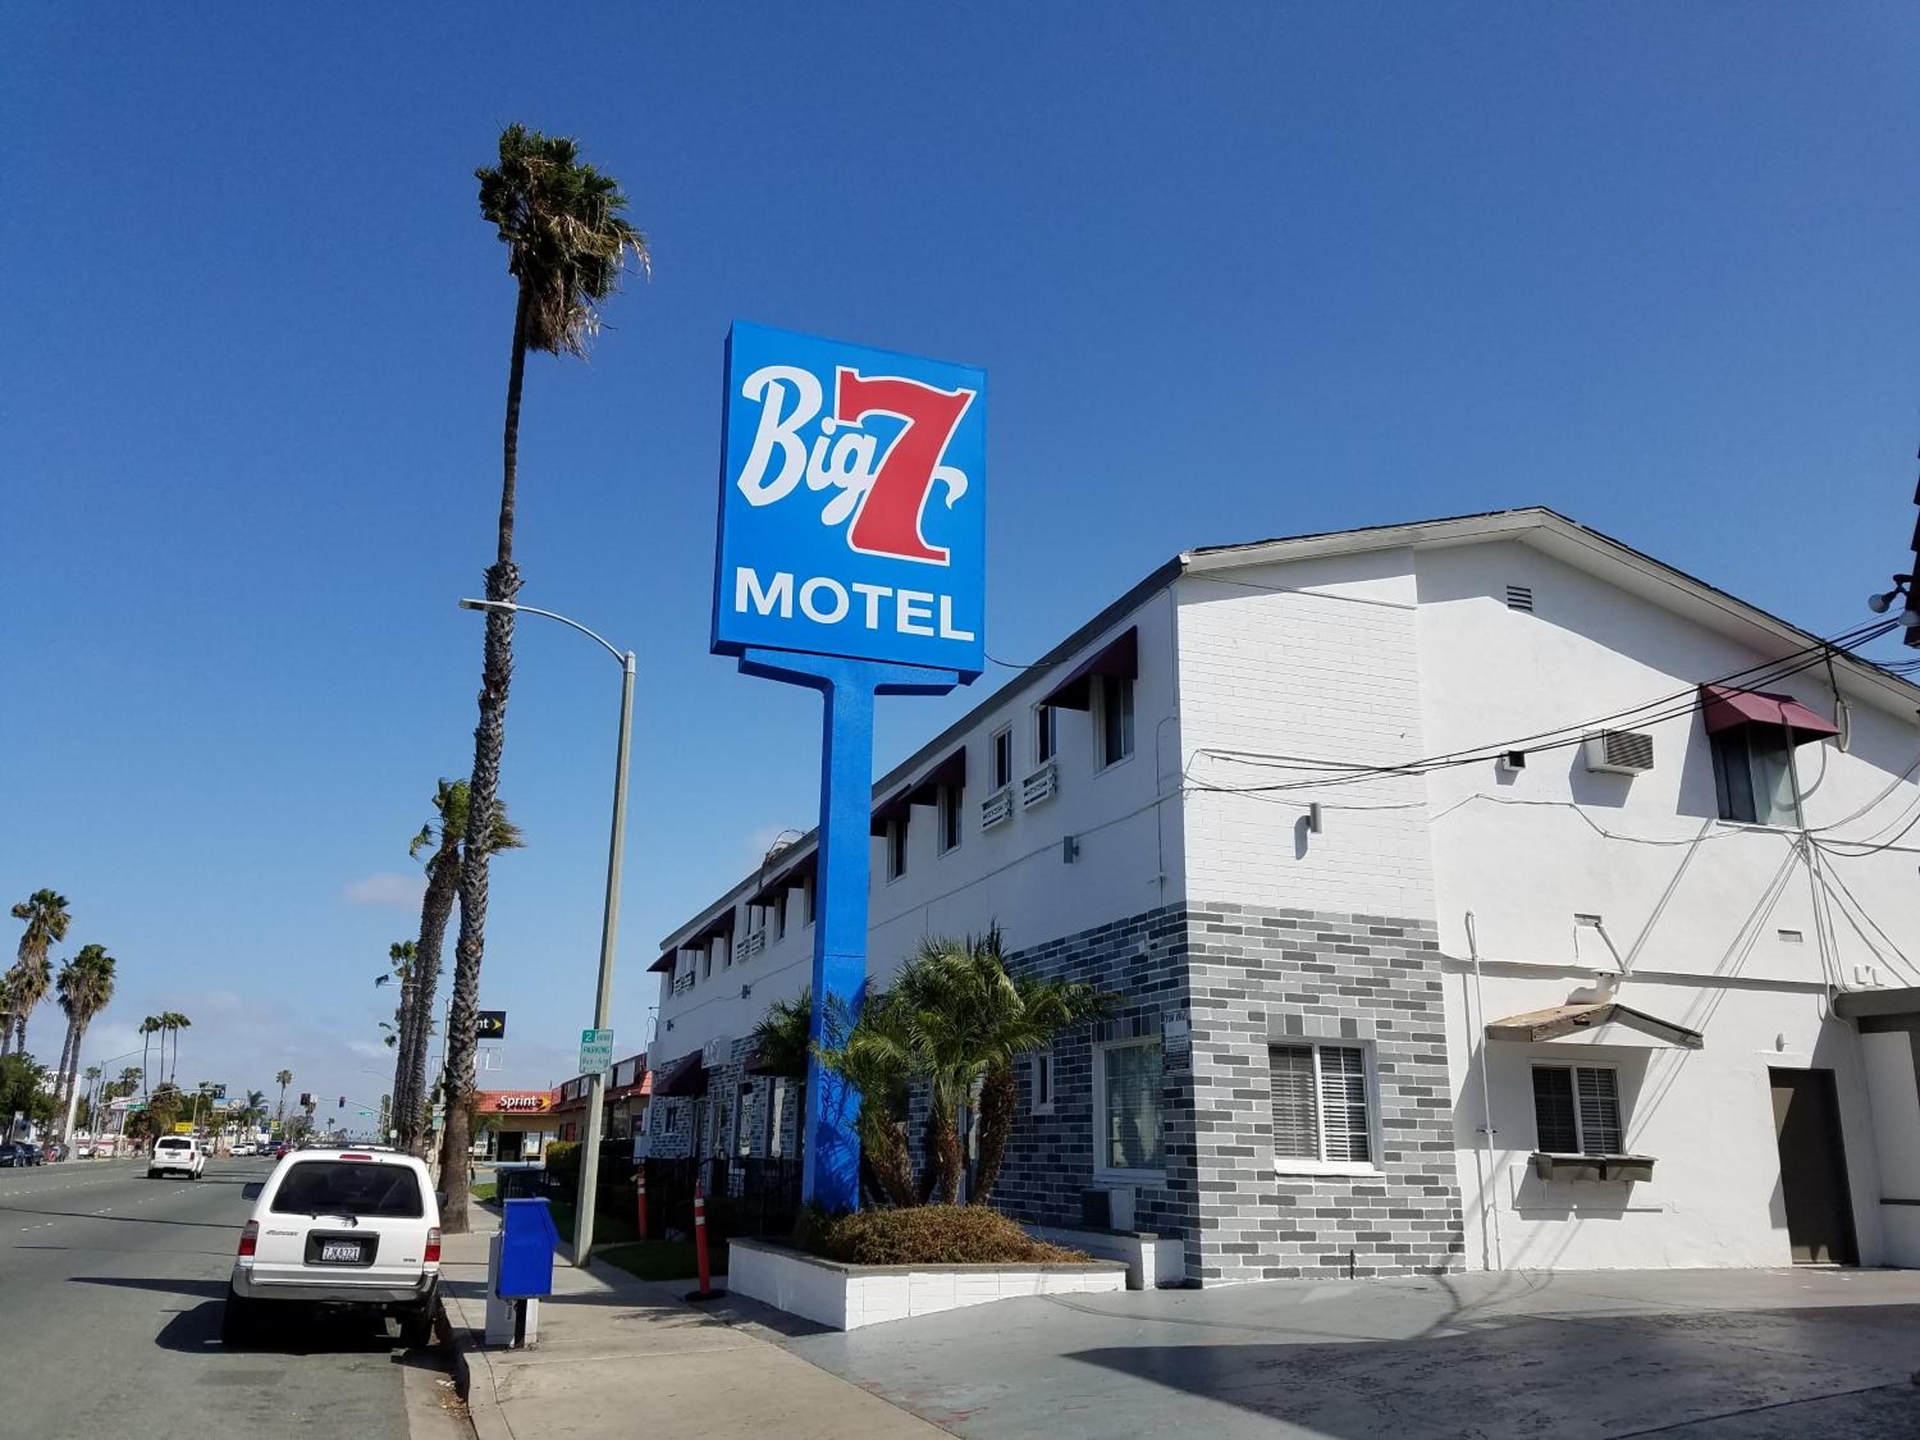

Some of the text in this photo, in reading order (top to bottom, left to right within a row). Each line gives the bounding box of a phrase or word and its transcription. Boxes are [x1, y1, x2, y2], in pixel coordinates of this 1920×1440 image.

[737, 365, 977, 567] Big 7
[735, 566, 974, 641] MOTEL
[583, 1046, 611, 1054] PARKING
[500, 1095, 537, 1108] Sprint
